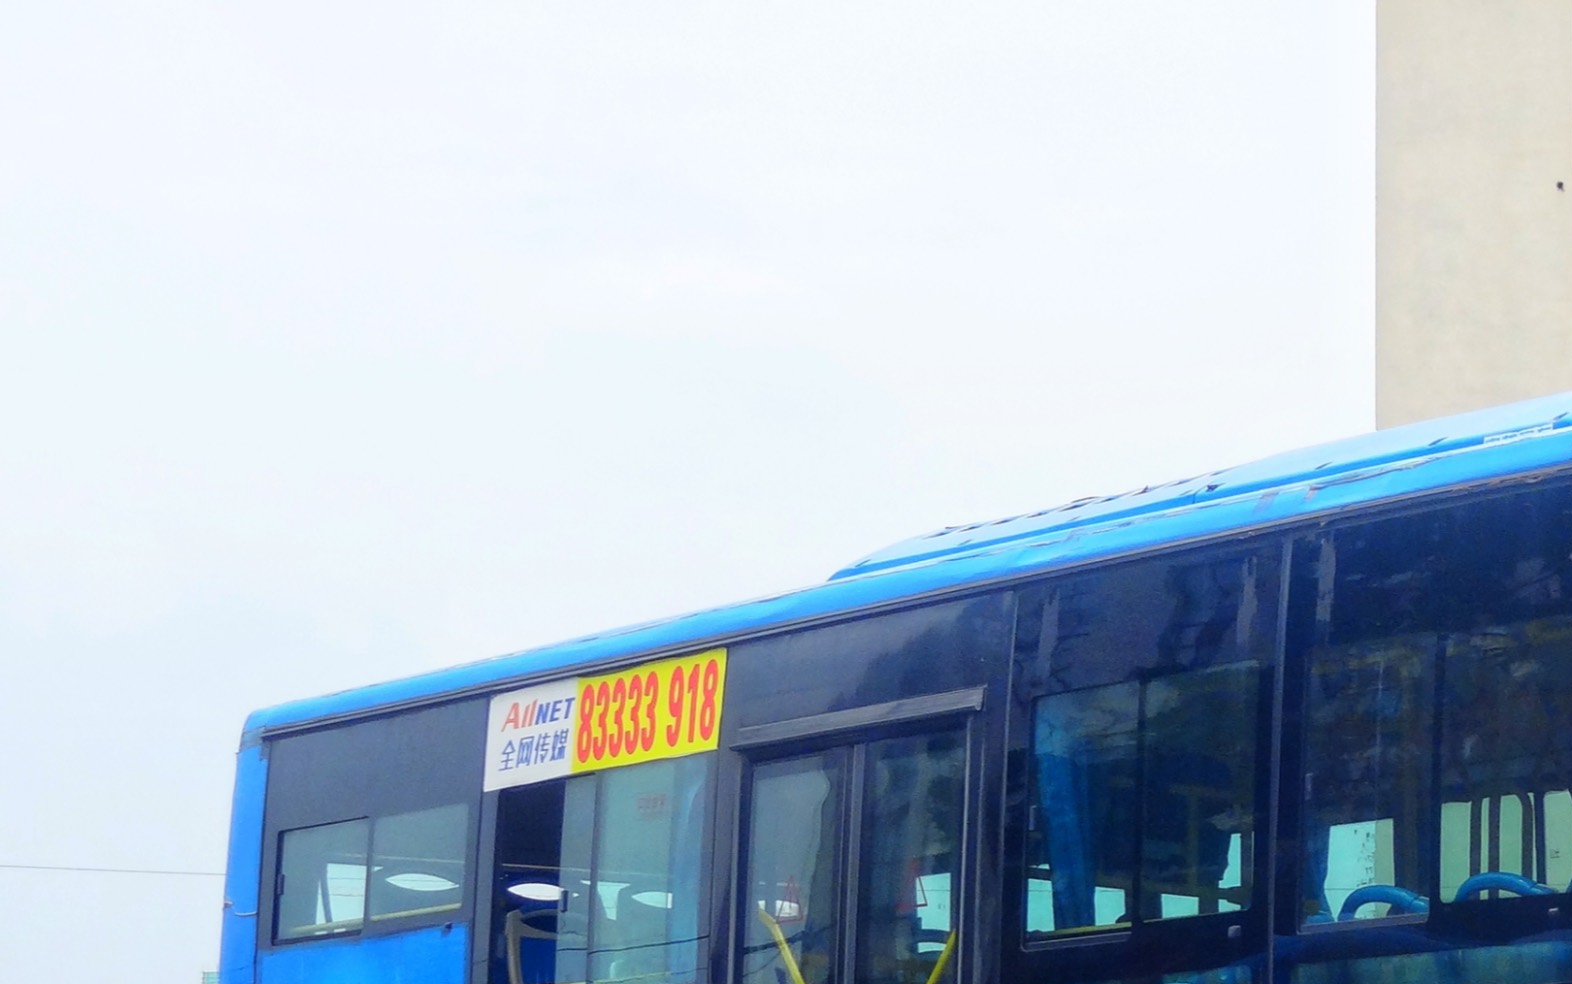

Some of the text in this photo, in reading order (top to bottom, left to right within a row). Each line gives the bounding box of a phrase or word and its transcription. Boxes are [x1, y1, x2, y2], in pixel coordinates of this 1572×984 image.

[576, 658, 719, 764] 83333 918
[498, 728, 570, 772] 全网传媒
